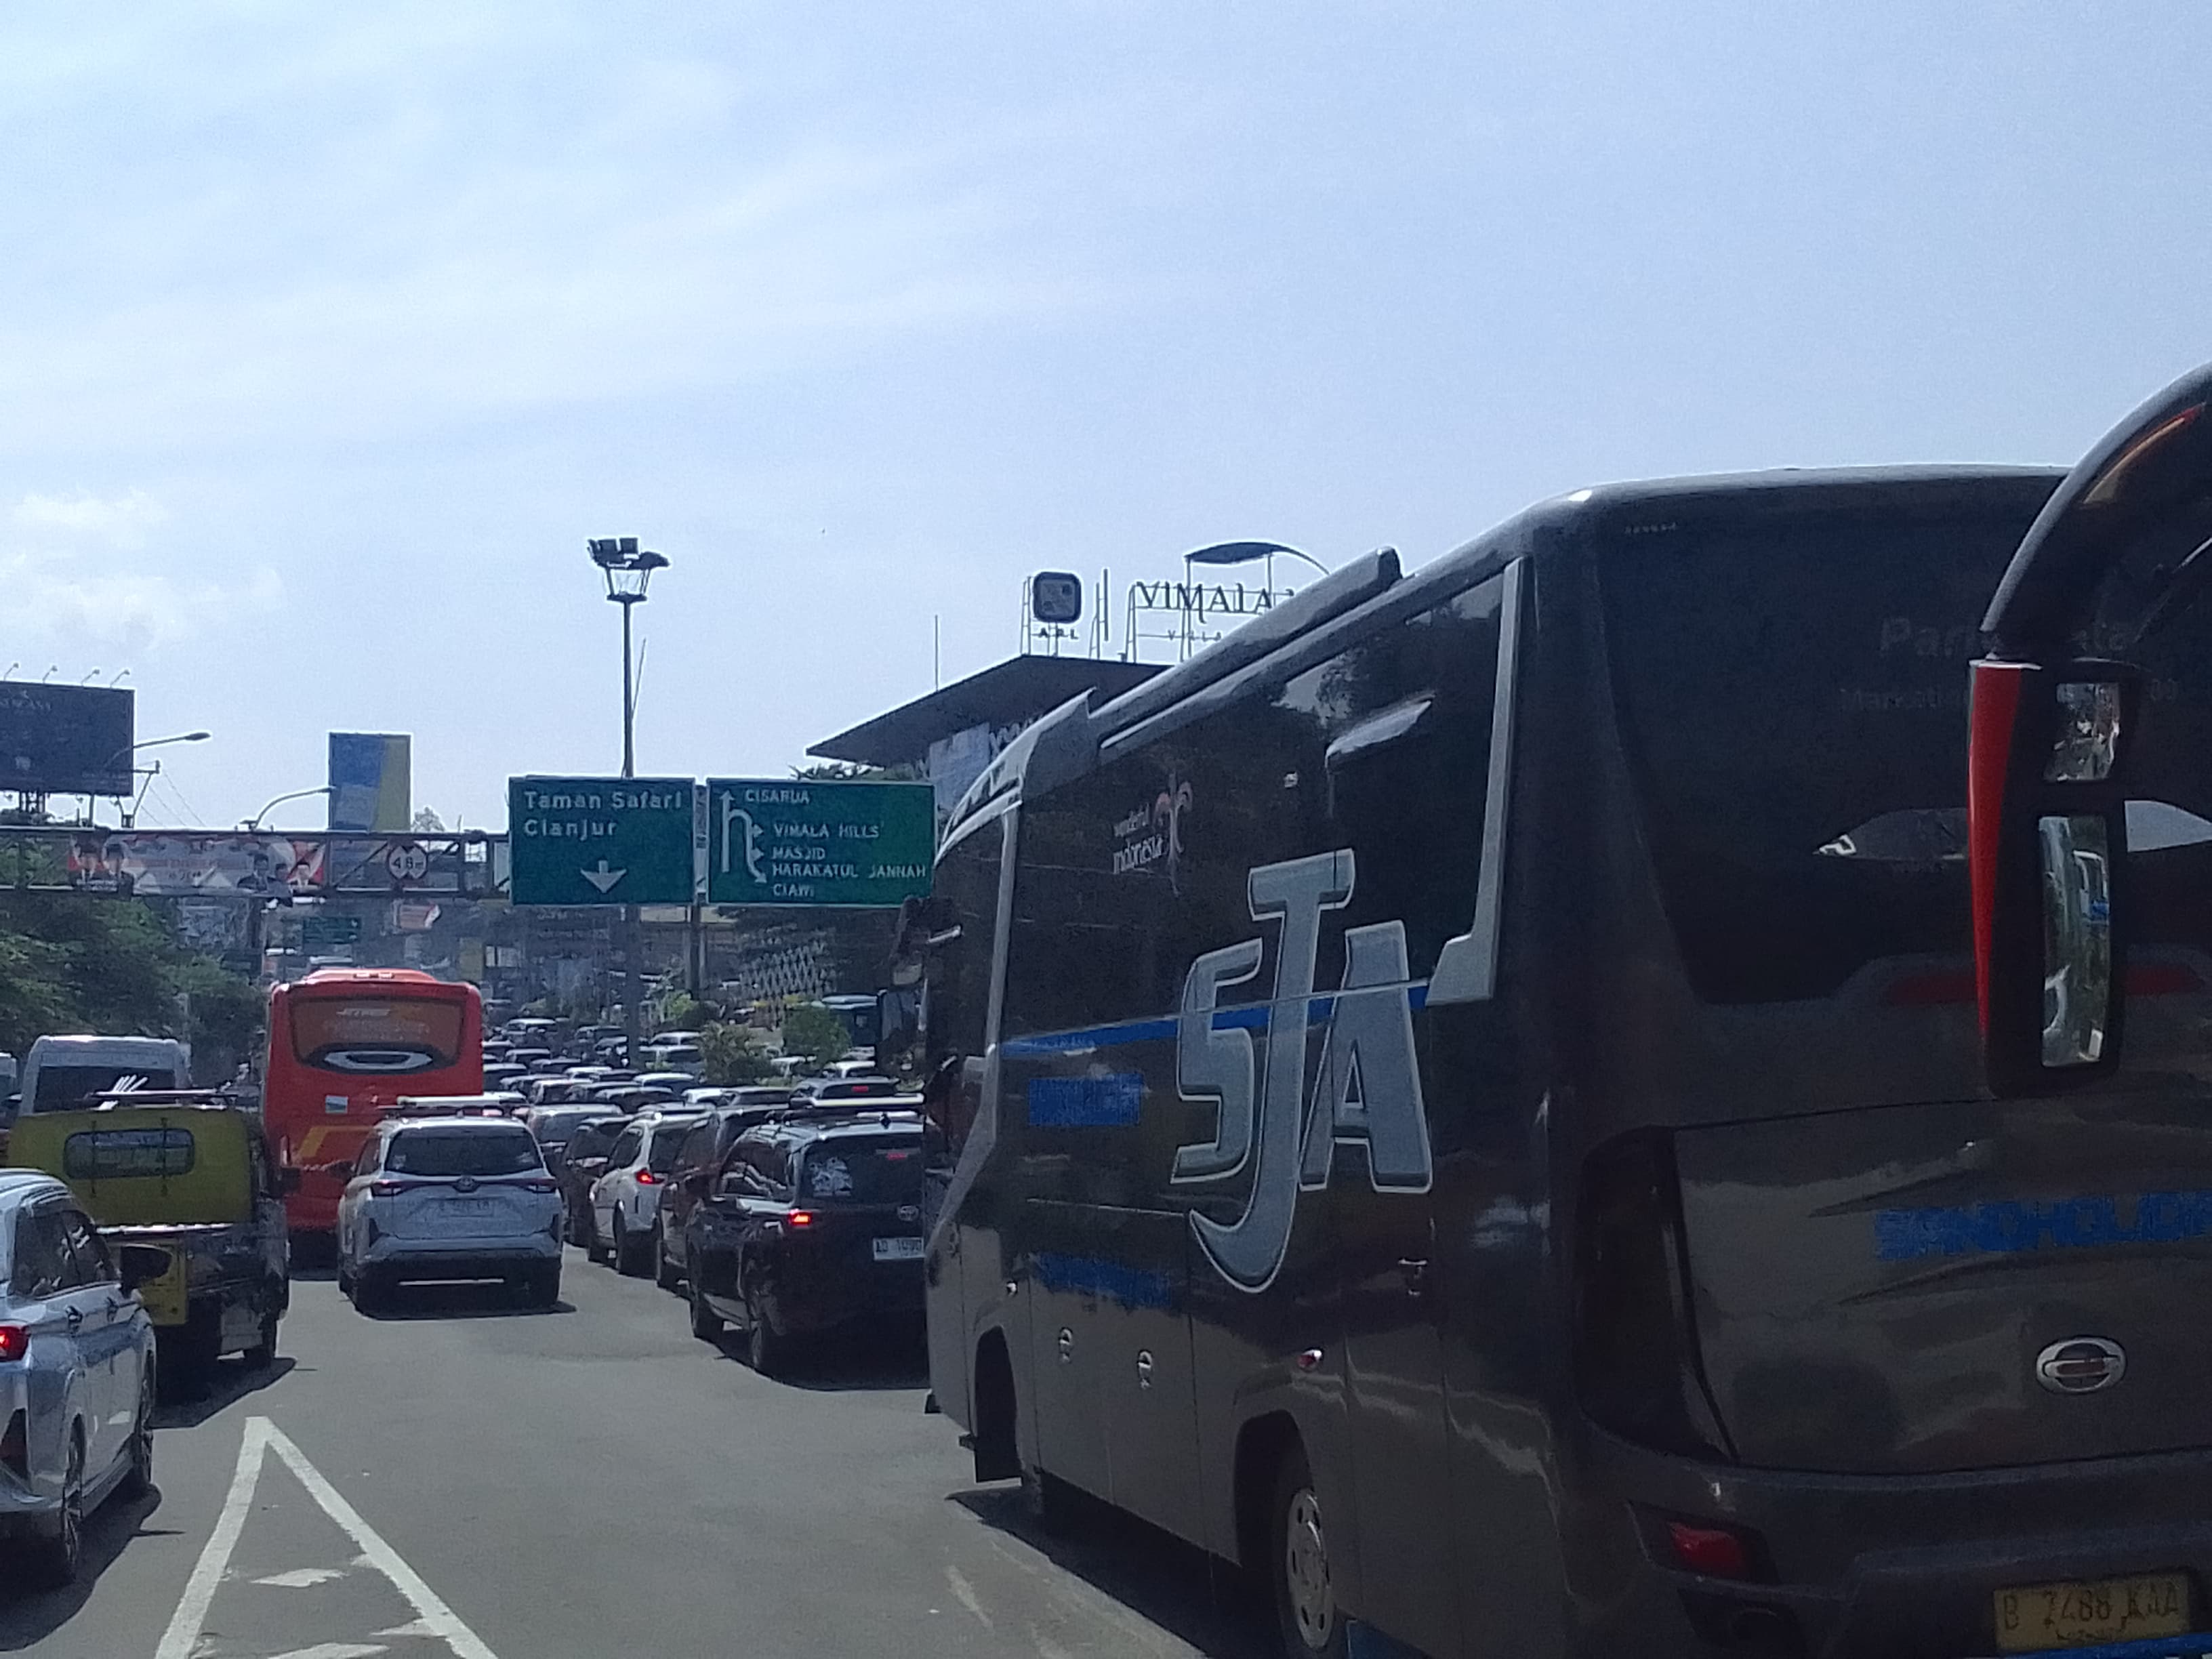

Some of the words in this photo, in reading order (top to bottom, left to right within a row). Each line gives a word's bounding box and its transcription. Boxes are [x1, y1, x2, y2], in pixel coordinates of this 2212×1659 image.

[523, 790, 602, 809] Taman
[612, 790, 682, 809] Safari
[745, 789, 810, 805] CISARUA
[524, 819, 619, 842] Cianjur
[773, 823, 830, 838] VIMALA
[838, 823, 880, 838] HILLS
[772, 846, 826, 861] MASJID
[867, 865, 926, 879] JANNAH
[773, 883, 815, 897] CIAWI
[2003, 1595, 2020, 1630] B
